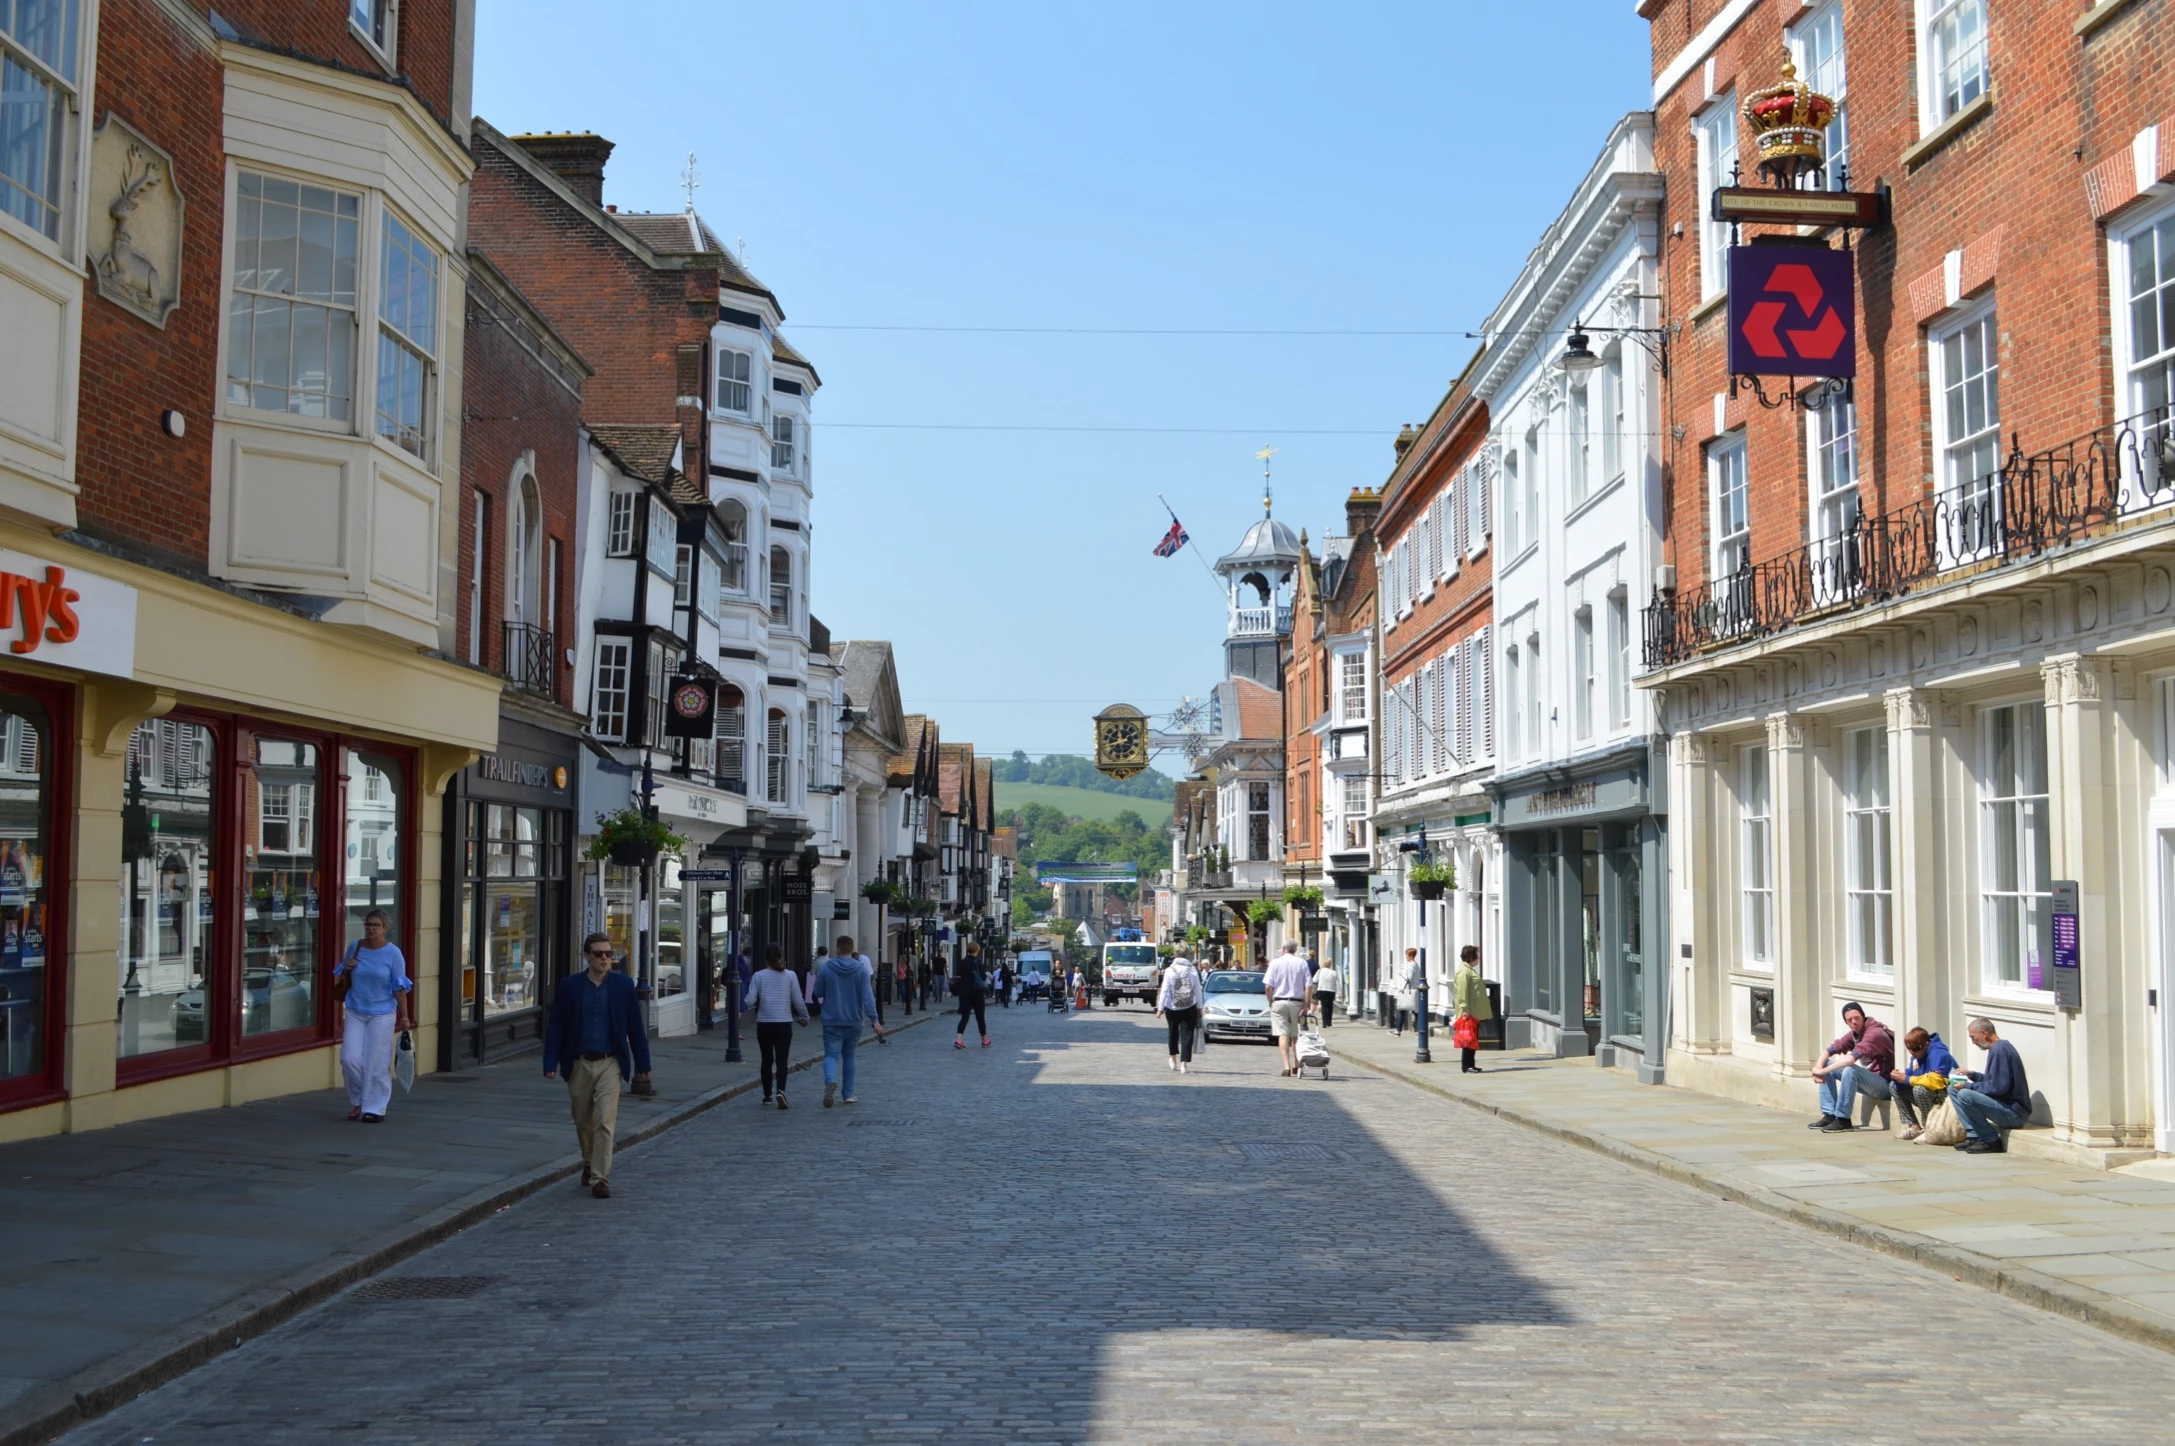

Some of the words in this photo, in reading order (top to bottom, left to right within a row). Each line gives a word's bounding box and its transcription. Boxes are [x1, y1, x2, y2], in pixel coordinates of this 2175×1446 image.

[1741, 198, 1750, 206] OF
[1753, 199, 1766, 207] THE
[1768, 200, 1796, 208] CROWN
[1805, 201, 1830, 210] FAMILY
[1831, 202, 1853, 211] HOTEL
[483, 754, 549, 788] TRAILFINDERS
